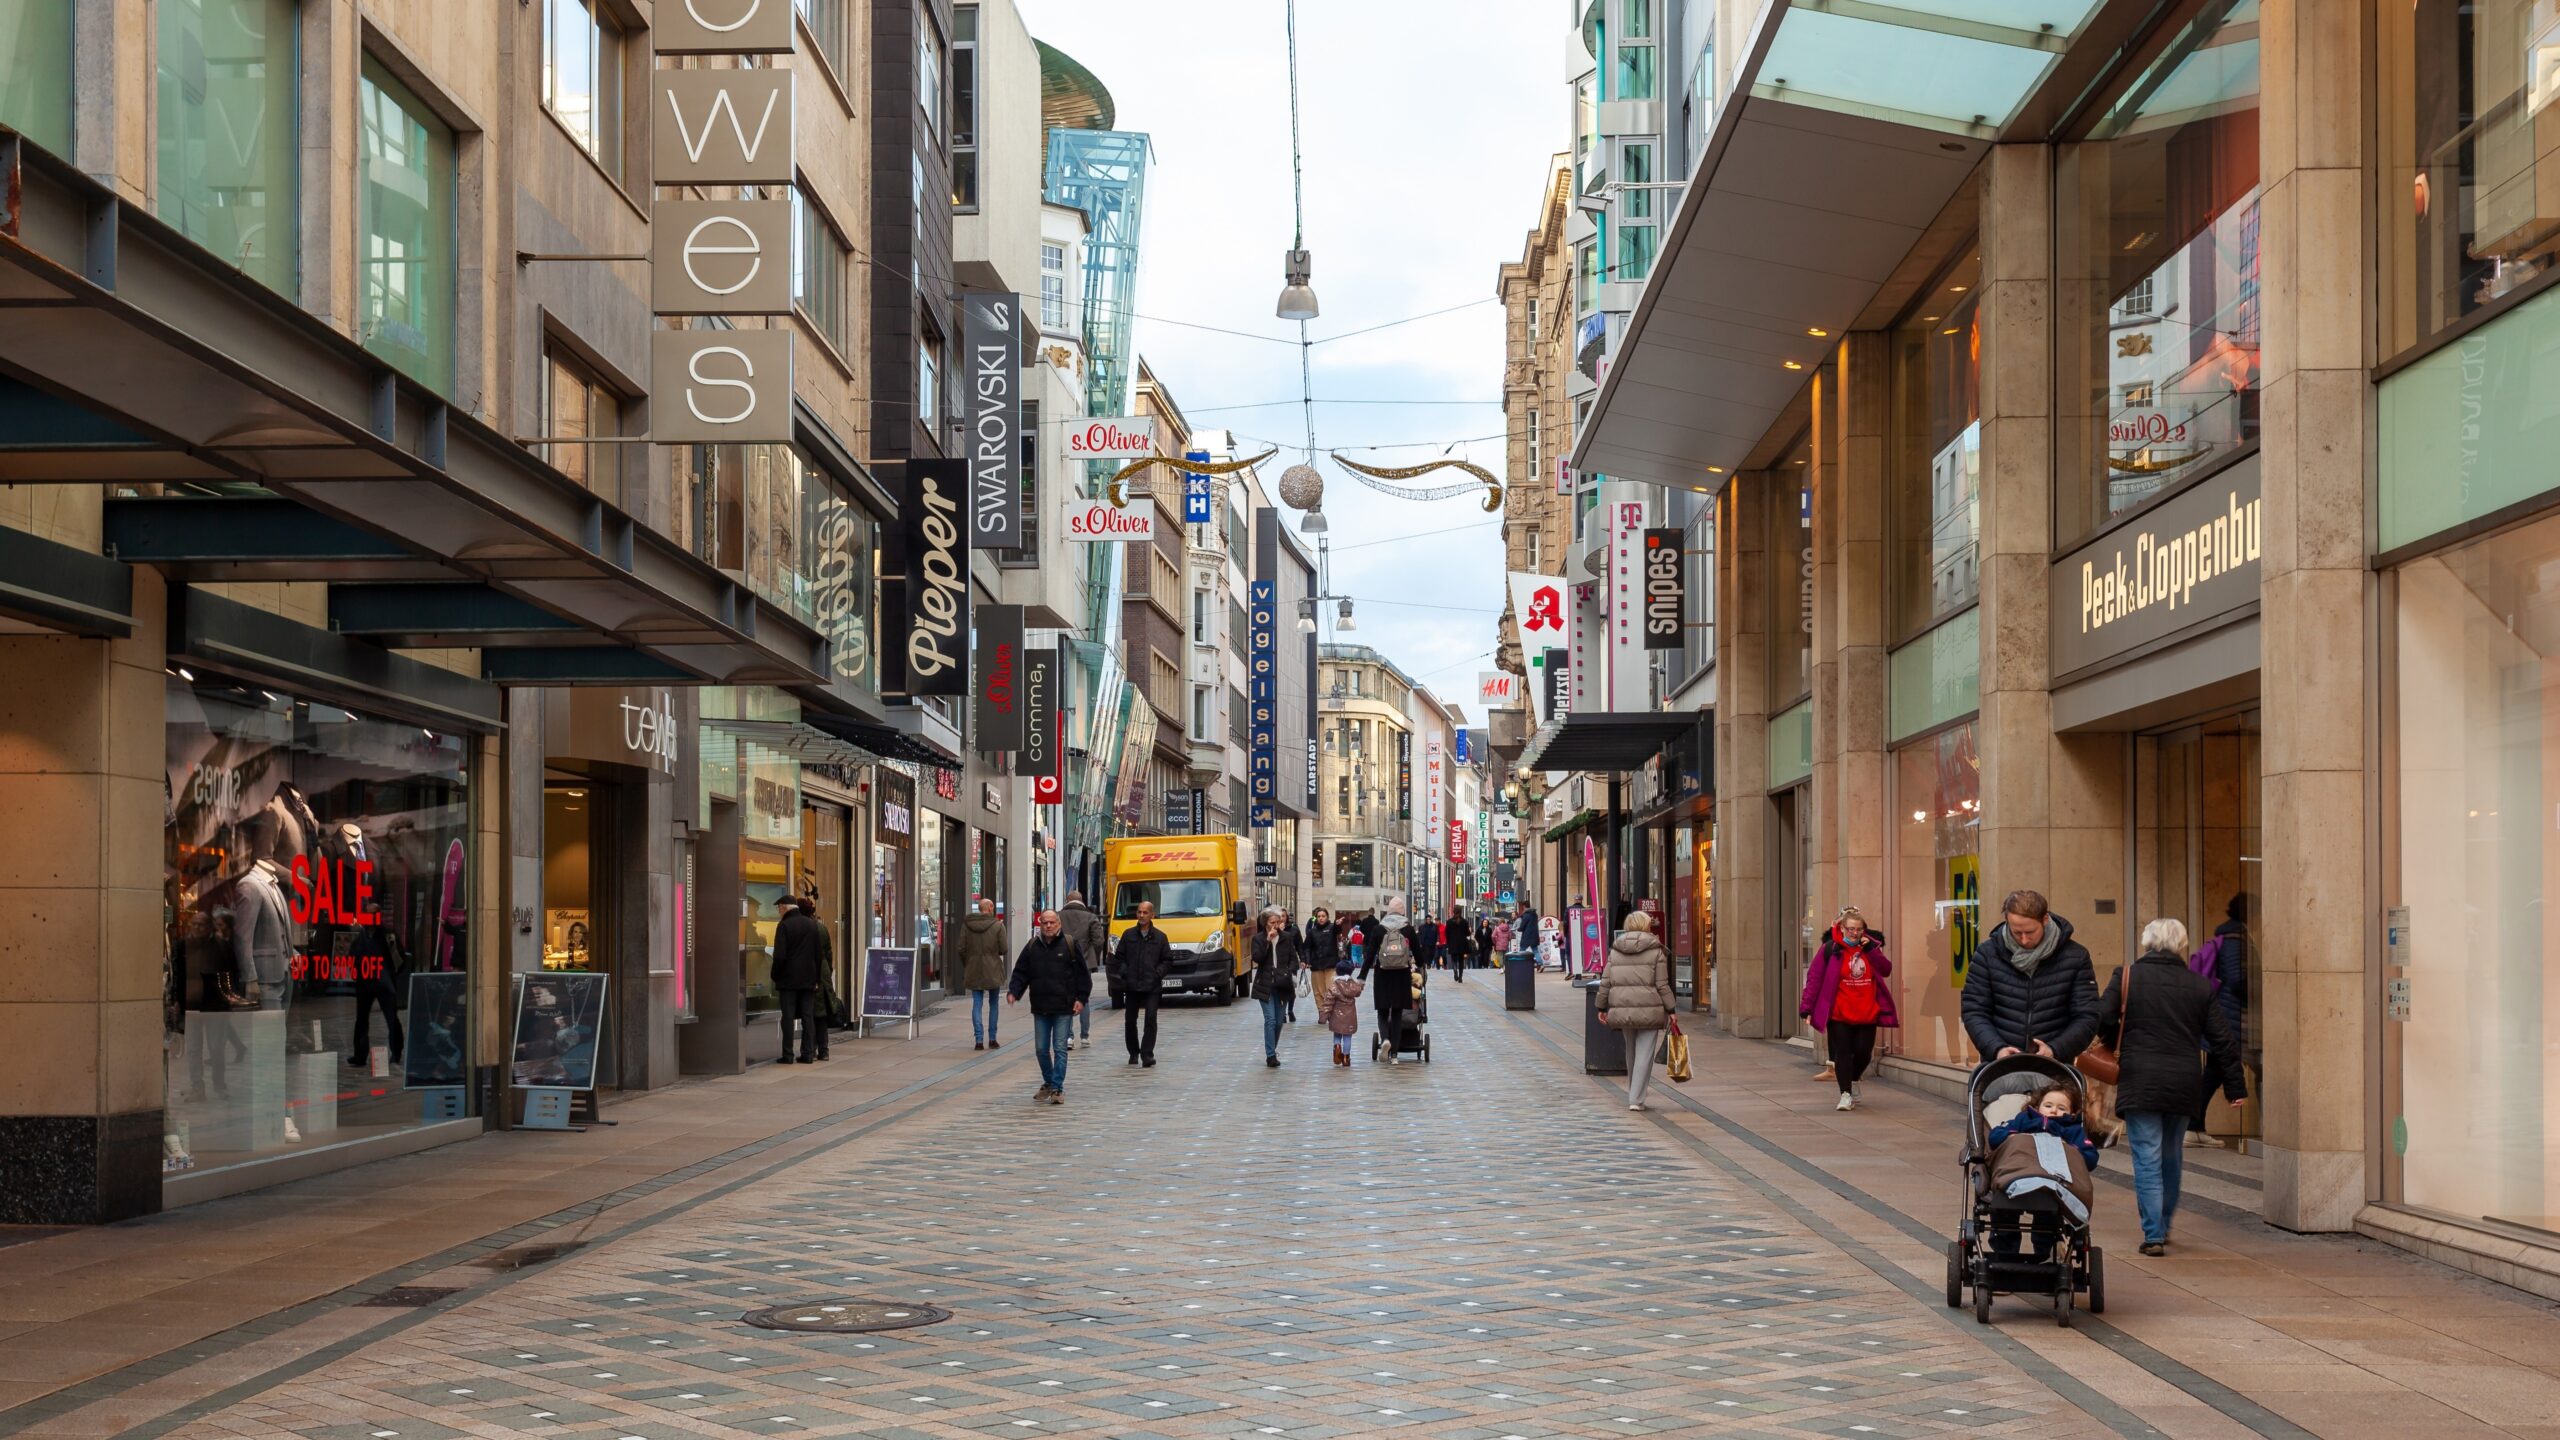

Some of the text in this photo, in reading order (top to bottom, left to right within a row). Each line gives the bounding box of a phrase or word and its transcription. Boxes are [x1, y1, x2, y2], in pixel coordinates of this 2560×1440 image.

[978, 344, 1007, 532] SWAROVSKI
[1071, 423, 1150, 451] s.Oliver
[1071, 506, 1150, 534] s.Oliver
[909, 477, 966, 676] Pieper
[1648, 548, 1683, 635] snipes
[1030, 663, 1046, 761] comma,
[1255, 587, 1270, 793] vogelsang
[1482, 678, 1509, 696] H&M
[1308, 738, 1317, 795] KARSTADT
[1428, 761, 1440, 834] Müller
[1140, 851, 1198, 863] DHL
[1452, 825, 1461, 858] HEMA
[1479, 812, 1488, 893] DEICHMANN
[290, 854, 381, 926] SALE.
[554, 910, 588, 921] Chopard
[291, 955, 384, 980] UP TO 30% OFF
